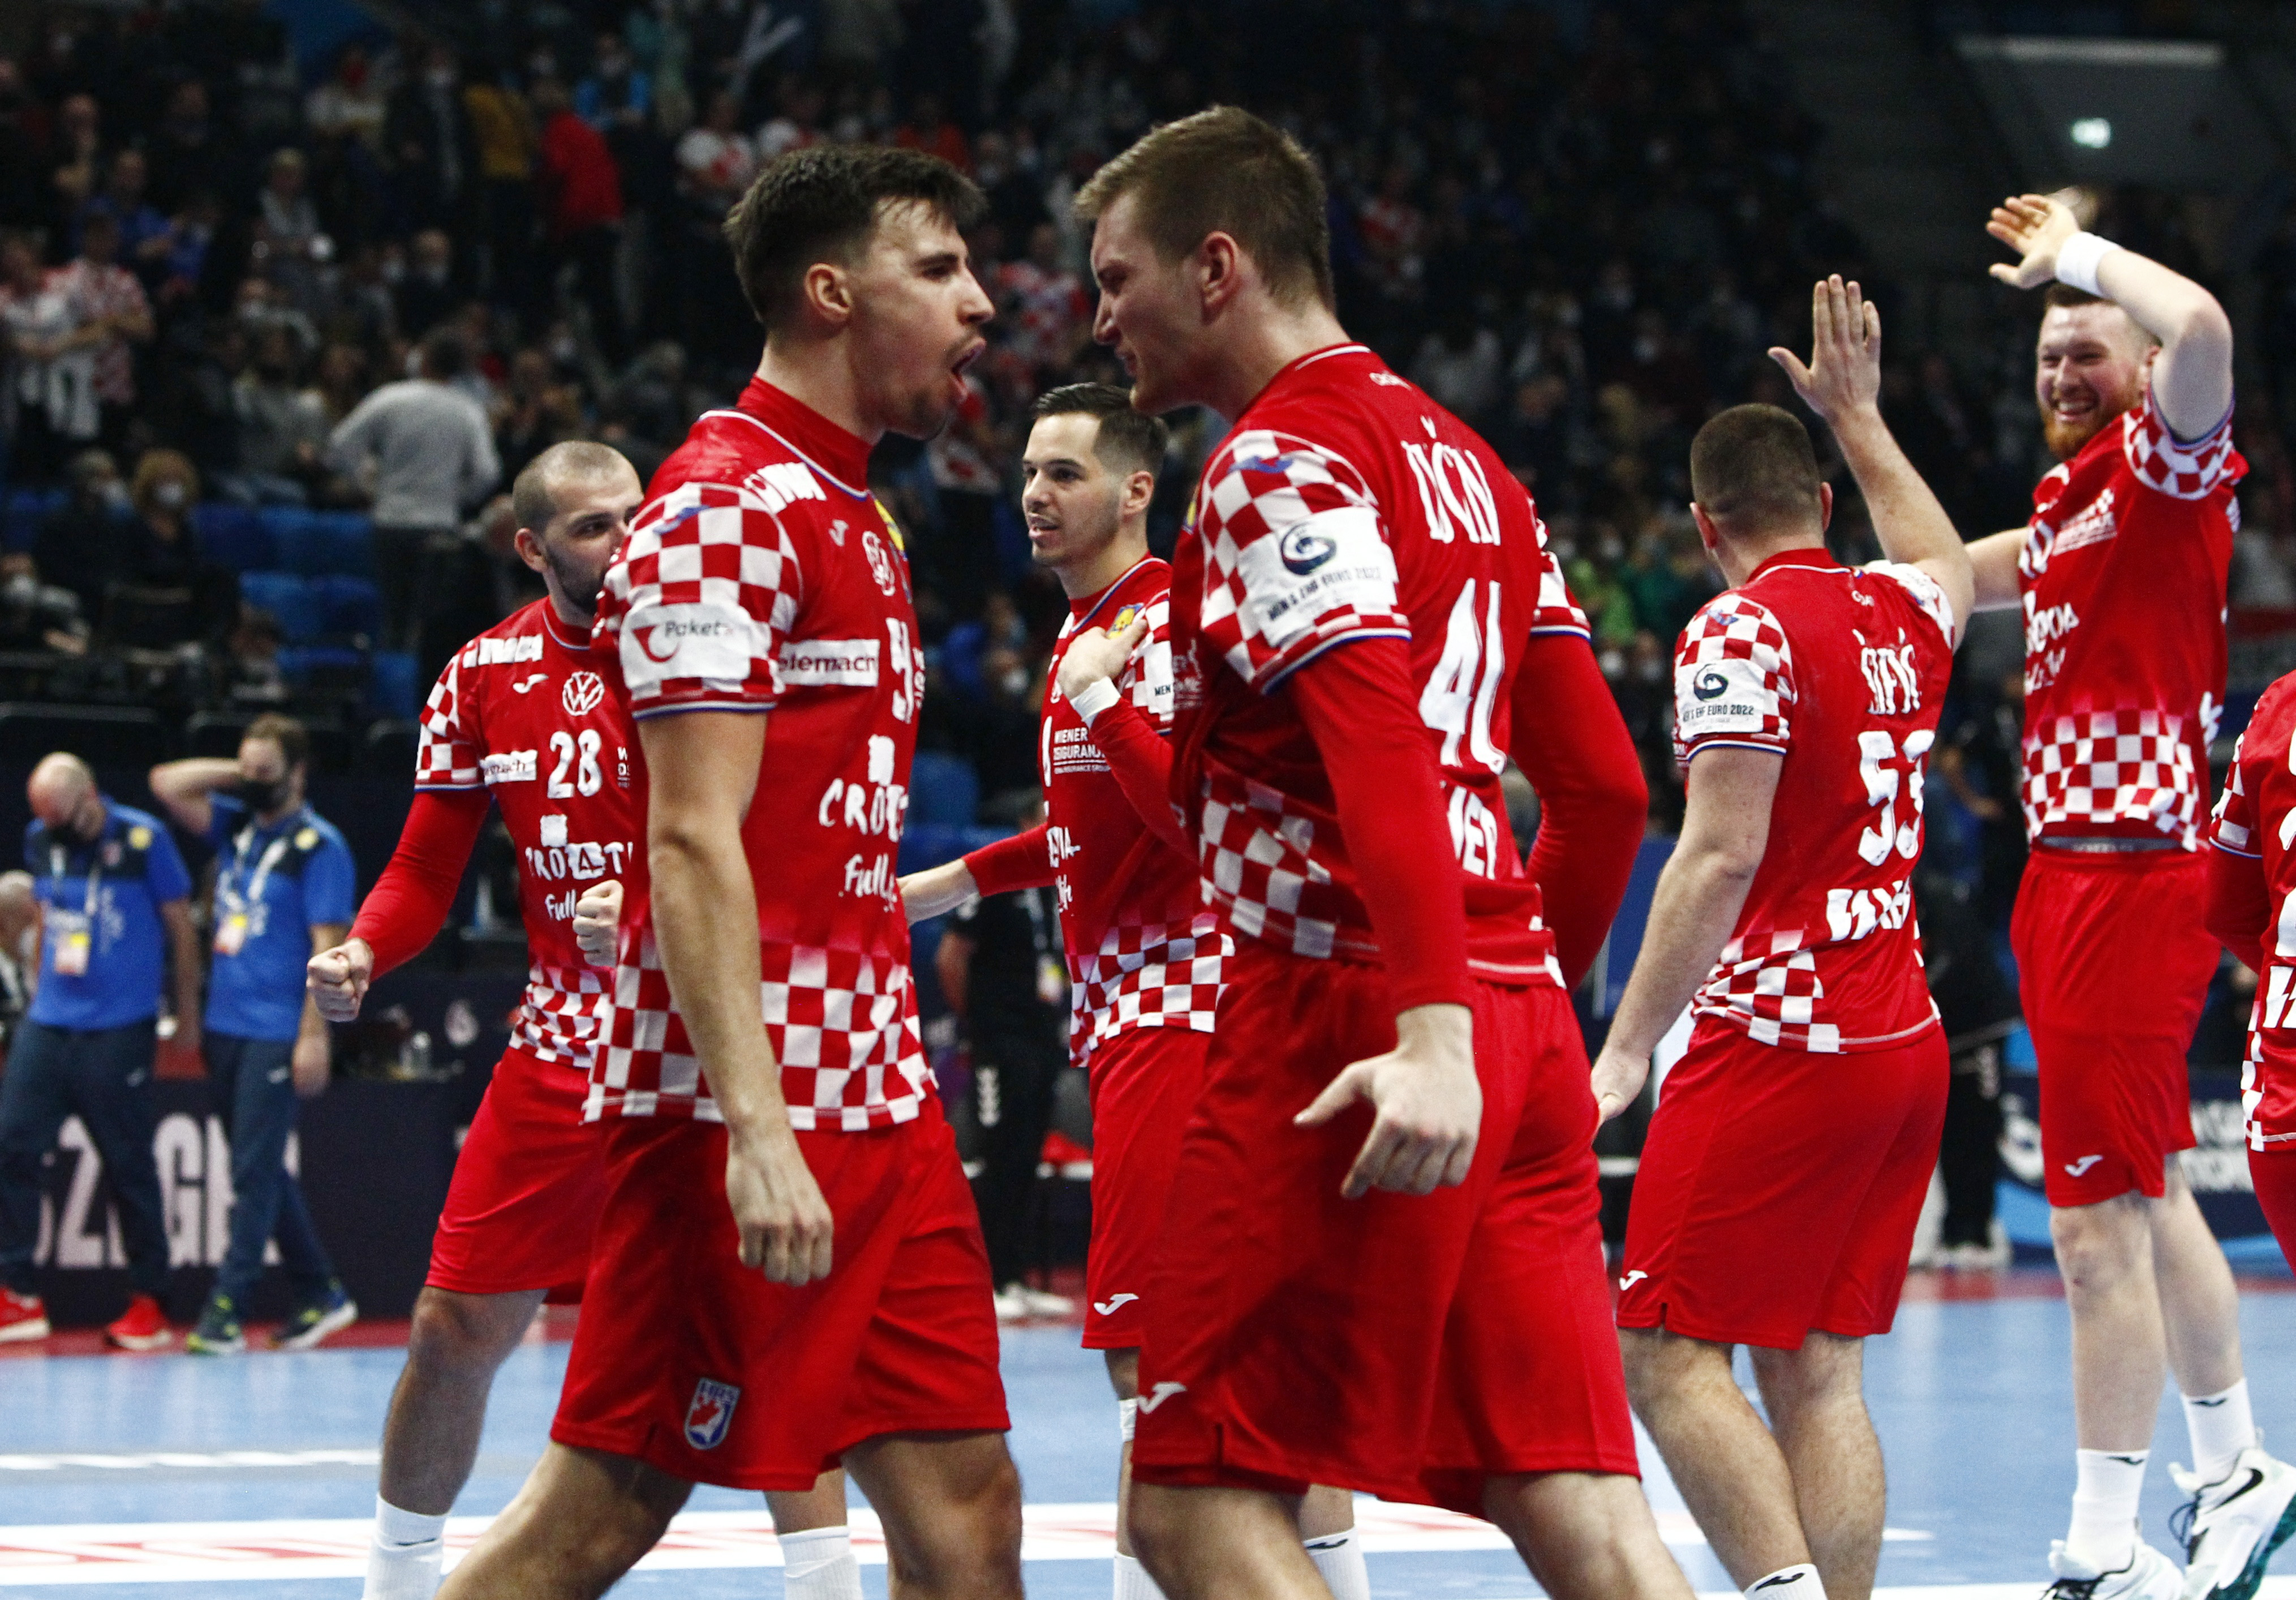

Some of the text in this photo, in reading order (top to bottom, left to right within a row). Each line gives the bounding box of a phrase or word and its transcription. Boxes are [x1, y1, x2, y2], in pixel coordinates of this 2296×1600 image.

[1418, 578, 1506, 776] 41
[1708, 704, 1727, 716] EURO
[1730, 704, 1754, 716] 2022
[547, 728, 603, 799] 28
[1858, 729, 1936, 867] 53
[544, 888, 577, 922] Full
